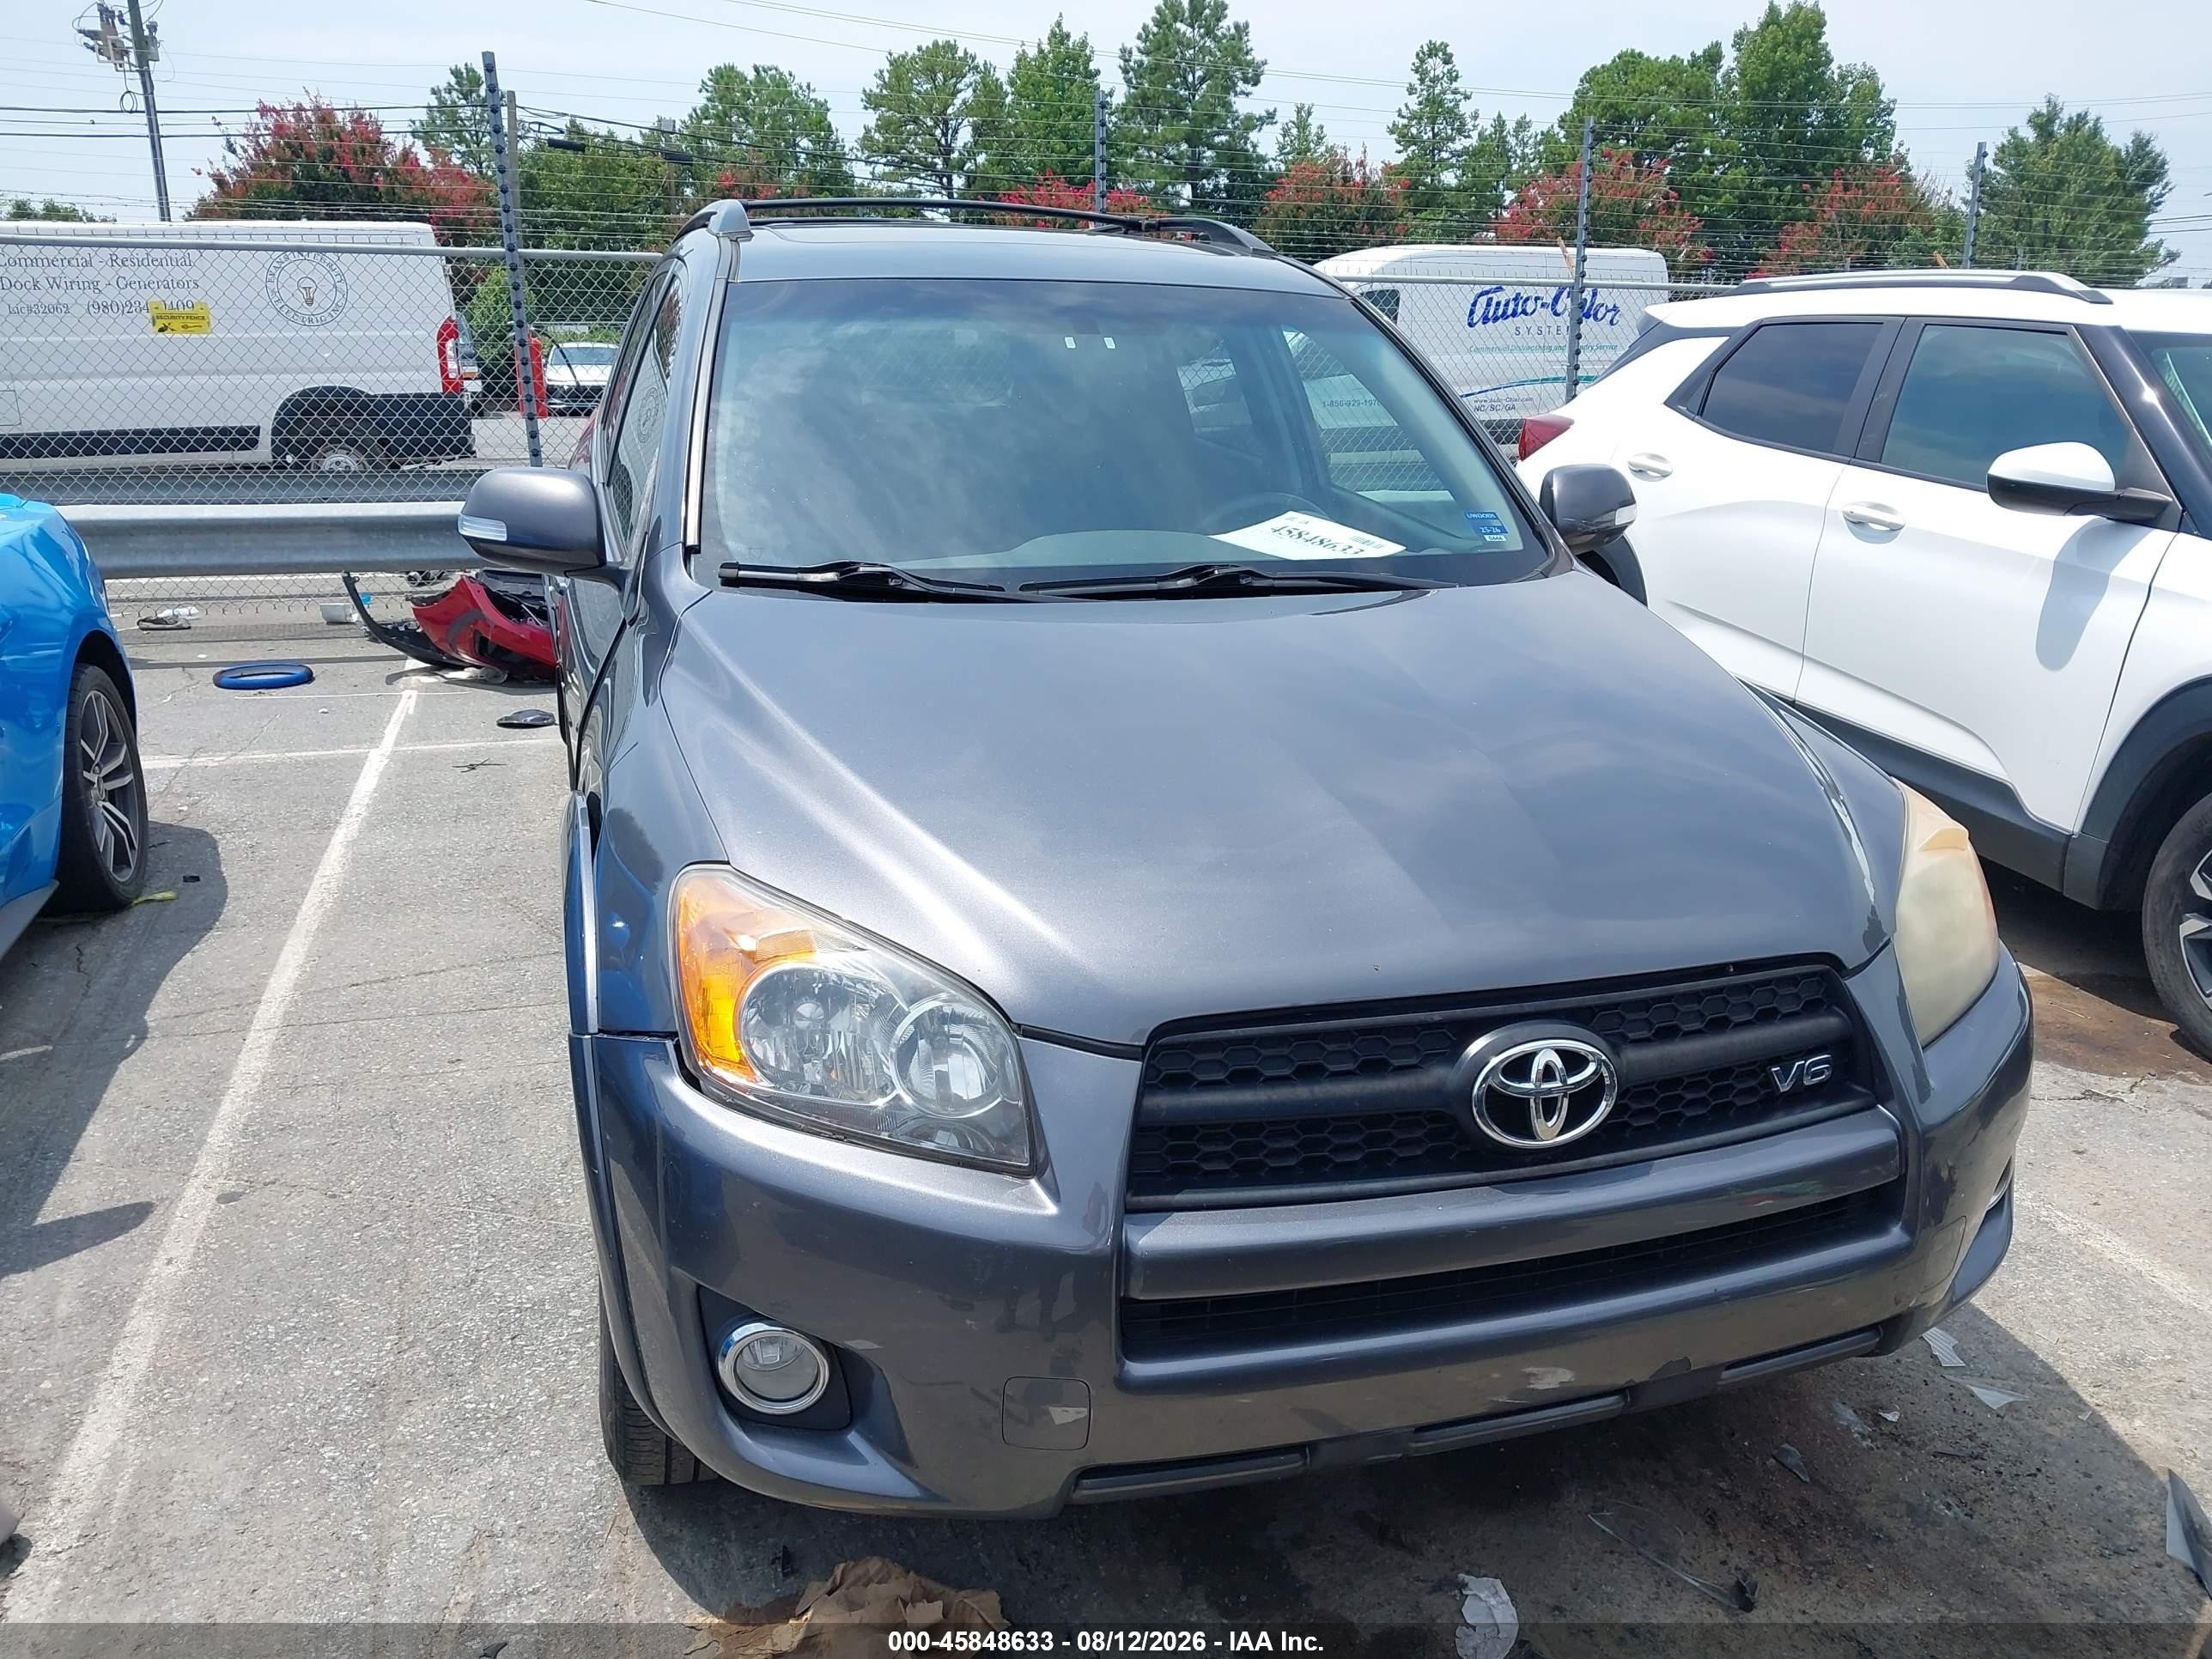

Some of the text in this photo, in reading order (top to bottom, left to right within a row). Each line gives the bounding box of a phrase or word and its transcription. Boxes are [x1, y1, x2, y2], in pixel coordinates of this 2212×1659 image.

[0, 252, 93, 268] Commercial
[109, 252, 192, 268] Residential
[267, 254, 290, 283] EVANS
[0, 276, 42, 290] Dock
[45, 276, 101, 294] Wiring
[116, 276, 199, 290] Generators
[8, 302, 70, 315] Lic#32062
[273, 298, 327, 325] ELECTRIC
[1553, 343, 1567, 354] and
[1595, 343, 1619, 353] Service
[1474, 404, 1516, 412] NC/SC/GA
[1271, 526, 1364, 555] 45848633
[1771, 1054, 1832, 1092] V6
